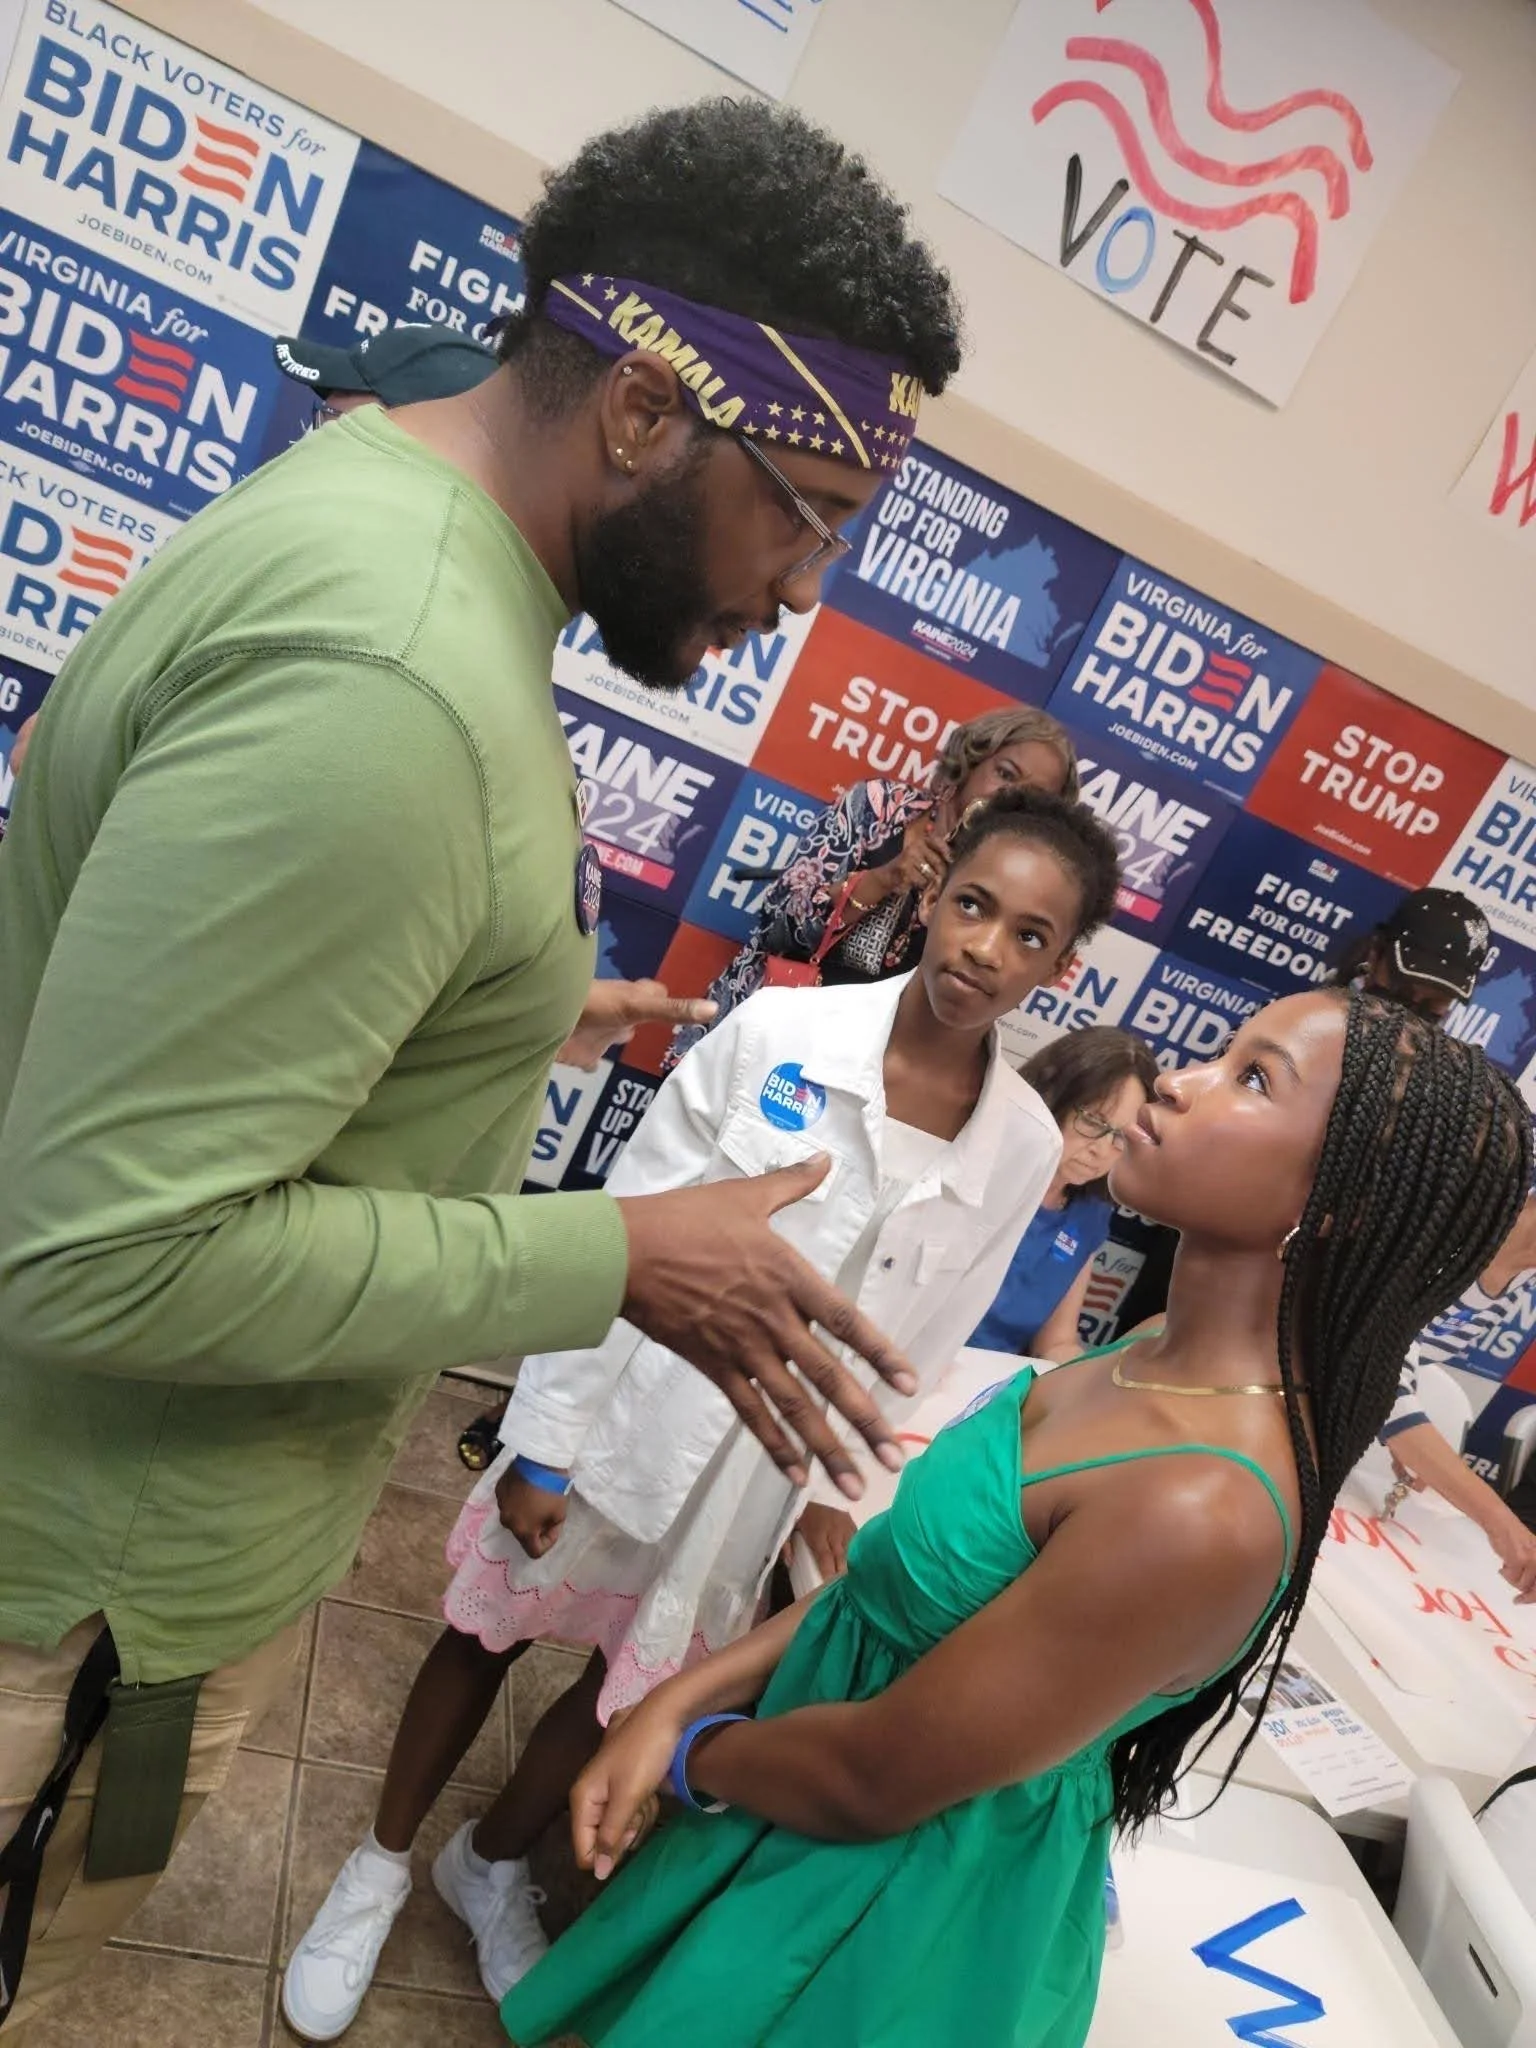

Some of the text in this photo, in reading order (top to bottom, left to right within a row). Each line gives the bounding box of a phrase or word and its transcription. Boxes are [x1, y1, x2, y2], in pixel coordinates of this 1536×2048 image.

[44, 0, 327, 158] BLACK VOTERS for
[23, 34, 325, 238] BIDEN
[6, 110, 302, 292] HARRIS
[76, 213, 213, 286] JOEBIDEN.COM
[1059, 152, 1276, 367] VOTE
[151, 307, 209, 344] for
[405, 287, 468, 331] FOR
[275, 343, 320, 381] RETIRED
[607, 291, 747, 430] KAMALA
[15, 420, 153, 490] JOEBIDEN.COM
[37, 477, 157, 543] VOTERS
[877, 489, 963, 558] UP FOR
[893, 455, 1010, 540] STANDING
[857, 523, 1022, 650] VIRGINIA
[1126, 571, 1268, 660] VIRGINIA for
[584, 673, 691, 723] JOEBIDEN.COM
[1094, 600, 1293, 734] BIDEN
[1071, 653, 1264, 773] HARRIS
[1107, 721, 1199, 772] JOEBIDEN.COM
[1299, 749, 1440, 837] TRUMP
[1333, 725, 1446, 793] STOP
[1247, 903, 1331, 952] FOR OUR
[1254, 873, 1354, 931] FIGHT
[600, 1105, 635, 1136] UP
